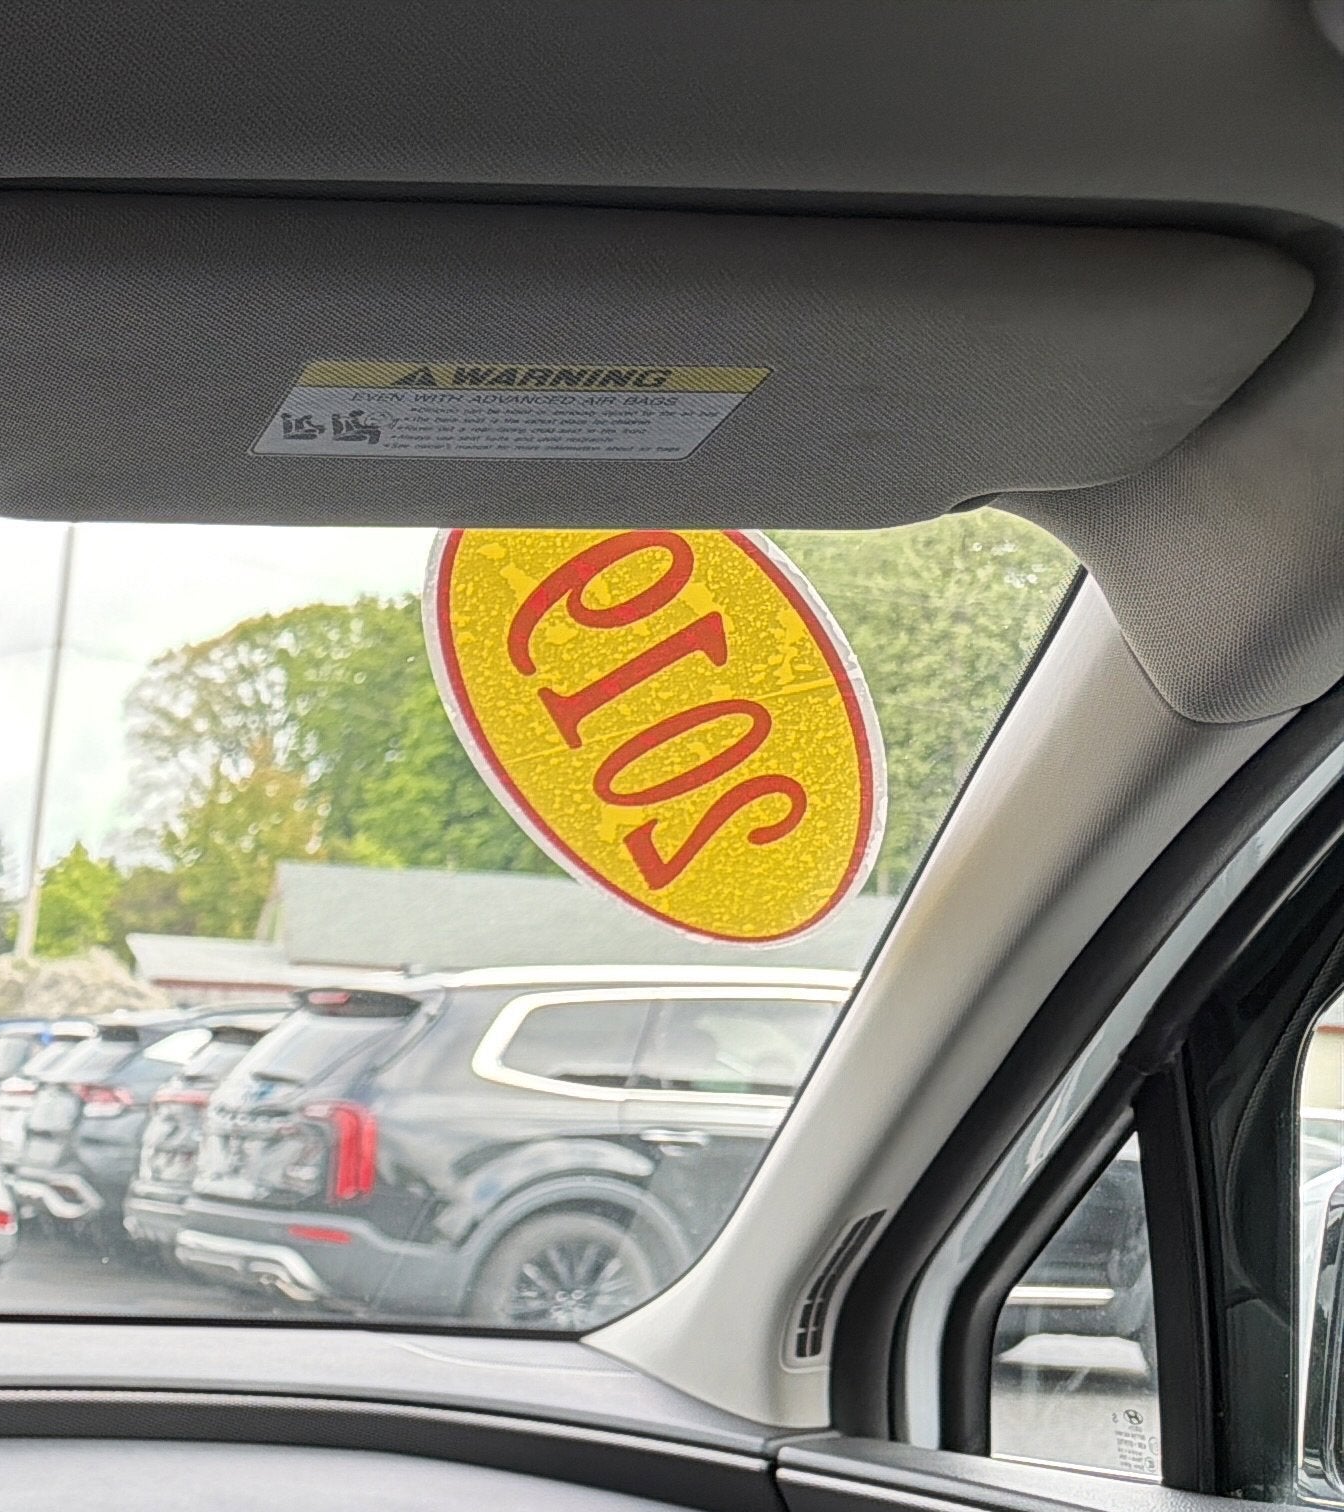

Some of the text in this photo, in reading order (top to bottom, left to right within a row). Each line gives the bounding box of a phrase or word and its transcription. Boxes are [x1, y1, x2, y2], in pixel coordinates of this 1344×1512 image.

[450, 366, 670, 389] WARNING
[351, 392, 679, 407] EVEN WITH ADVANCED AIR BAGS
